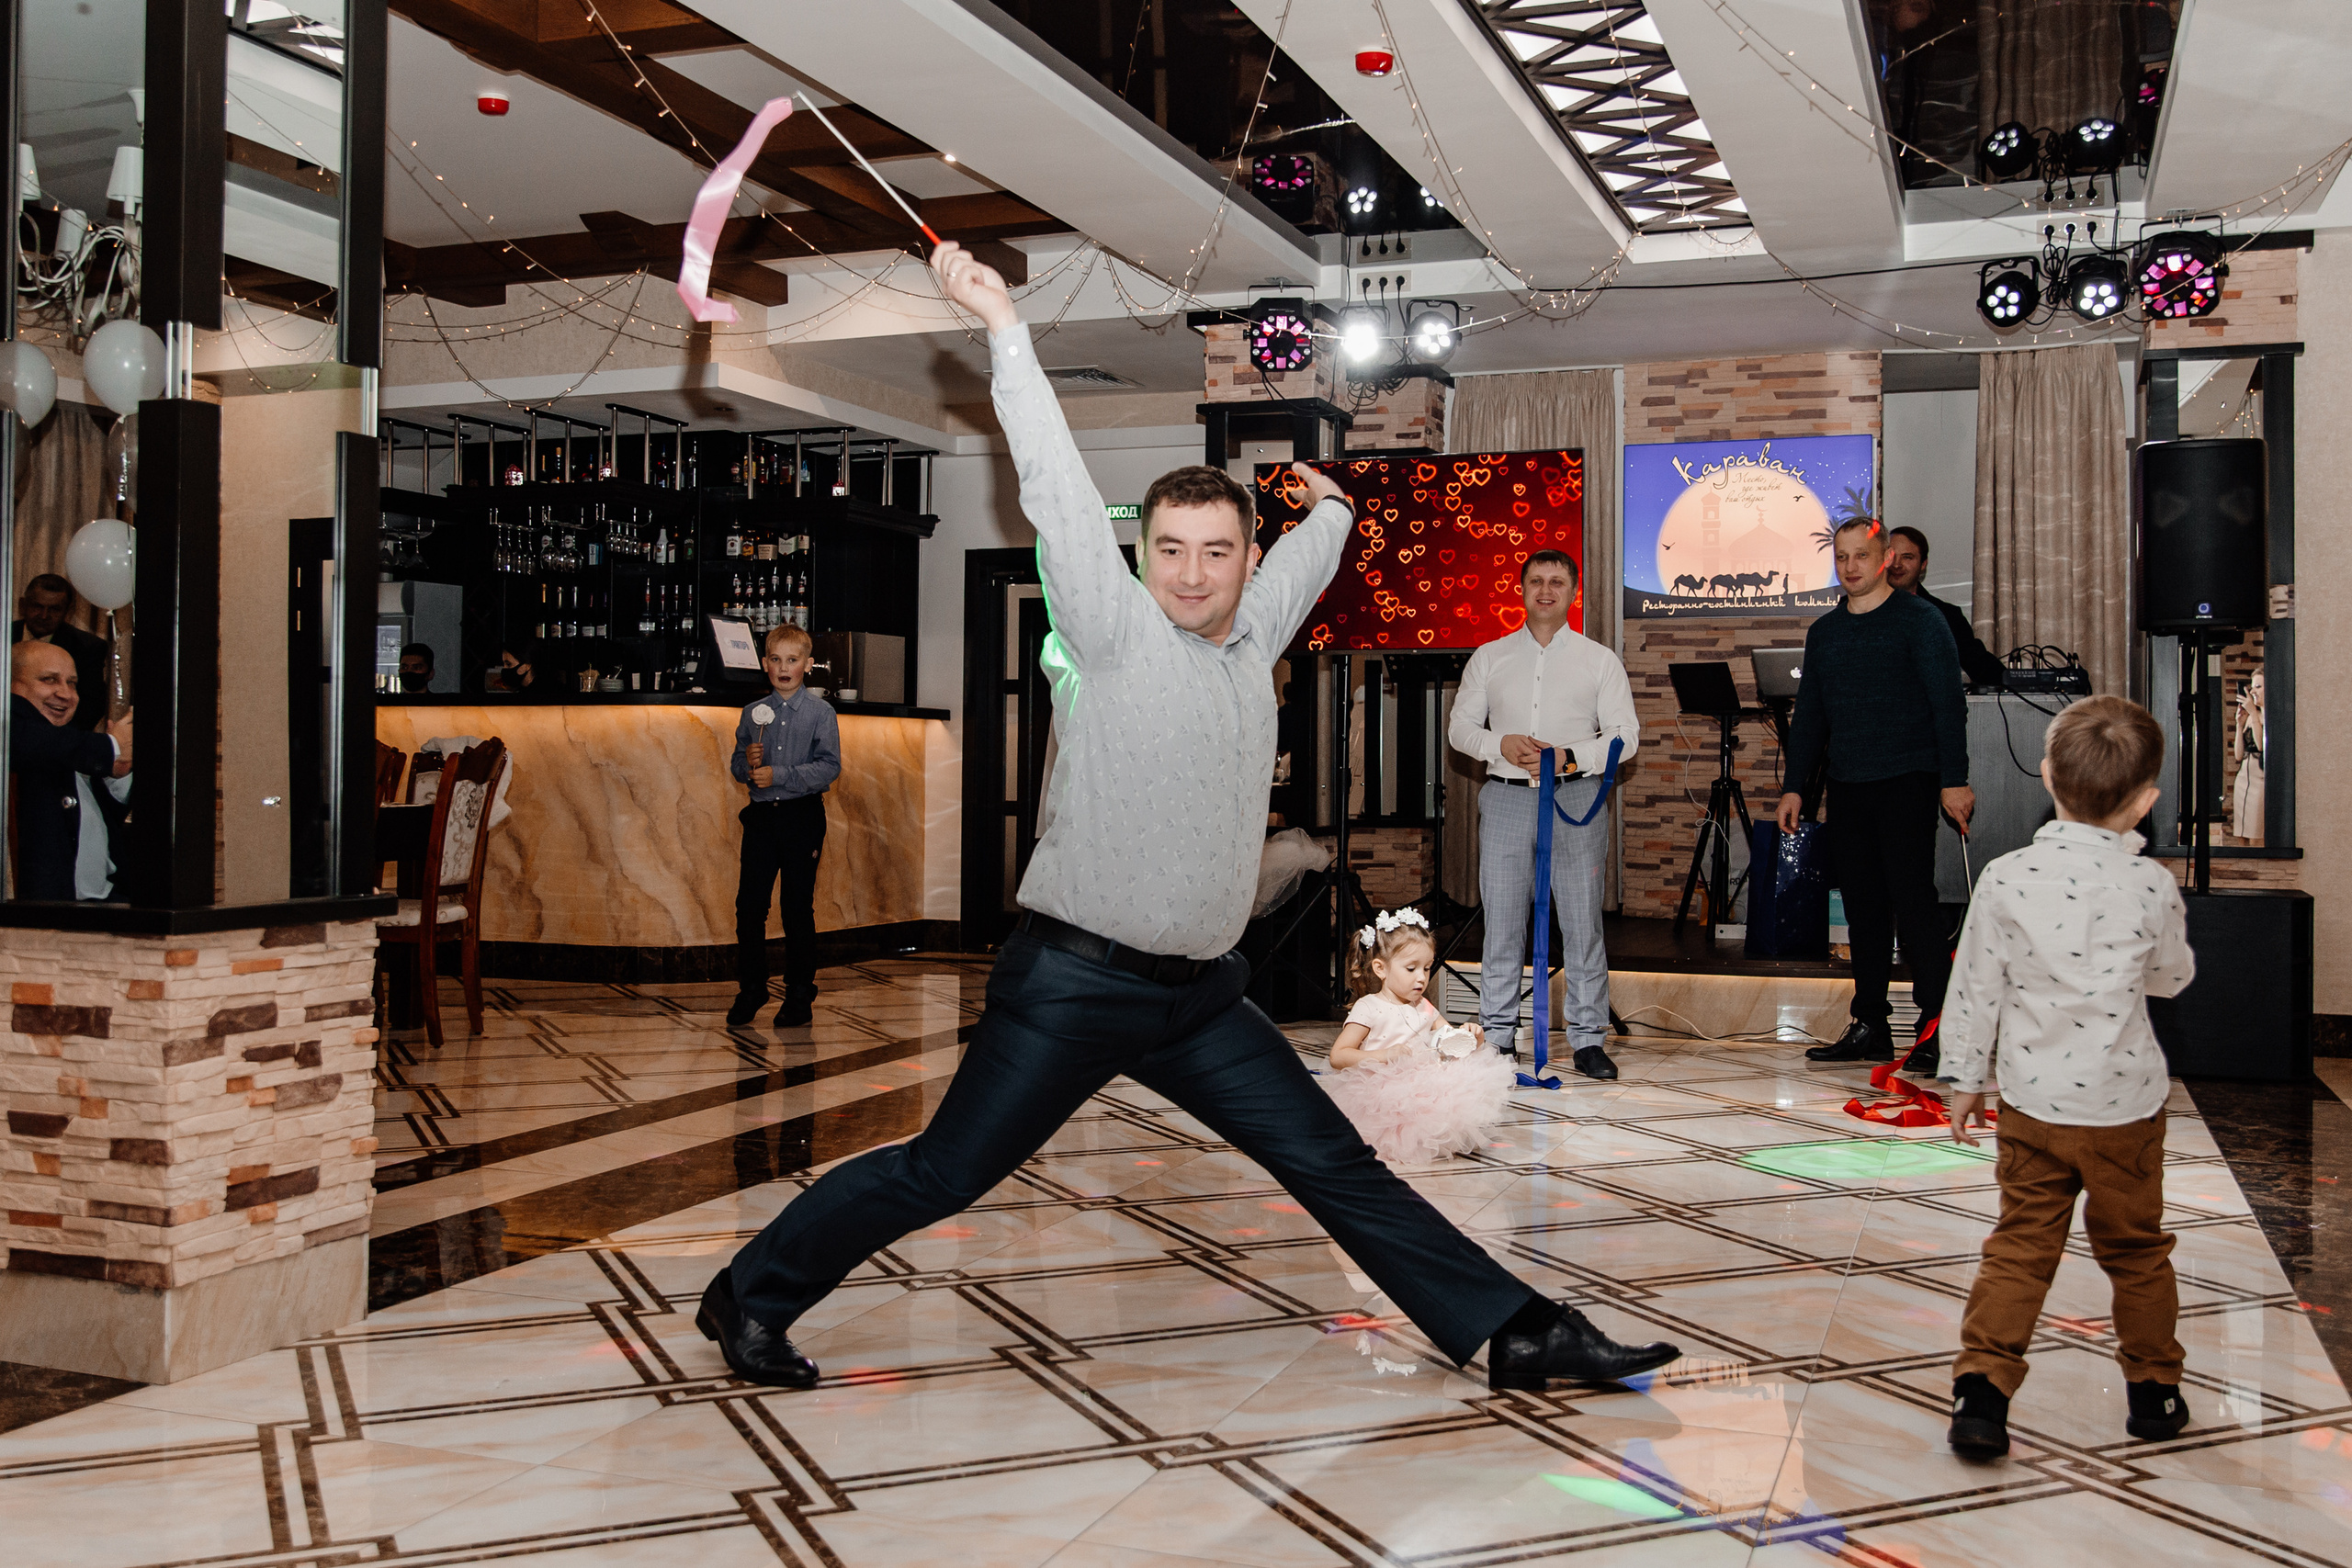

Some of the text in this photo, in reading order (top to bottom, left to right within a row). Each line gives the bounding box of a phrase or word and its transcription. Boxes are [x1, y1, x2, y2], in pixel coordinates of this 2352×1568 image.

[1671, 441, 1807, 490] Караван
[1732, 471, 1767, 484] Место,
[1108, 506, 1138, 518] ХОД
[1642, 594, 1841, 615] Ресторанно-гостиничный компле
